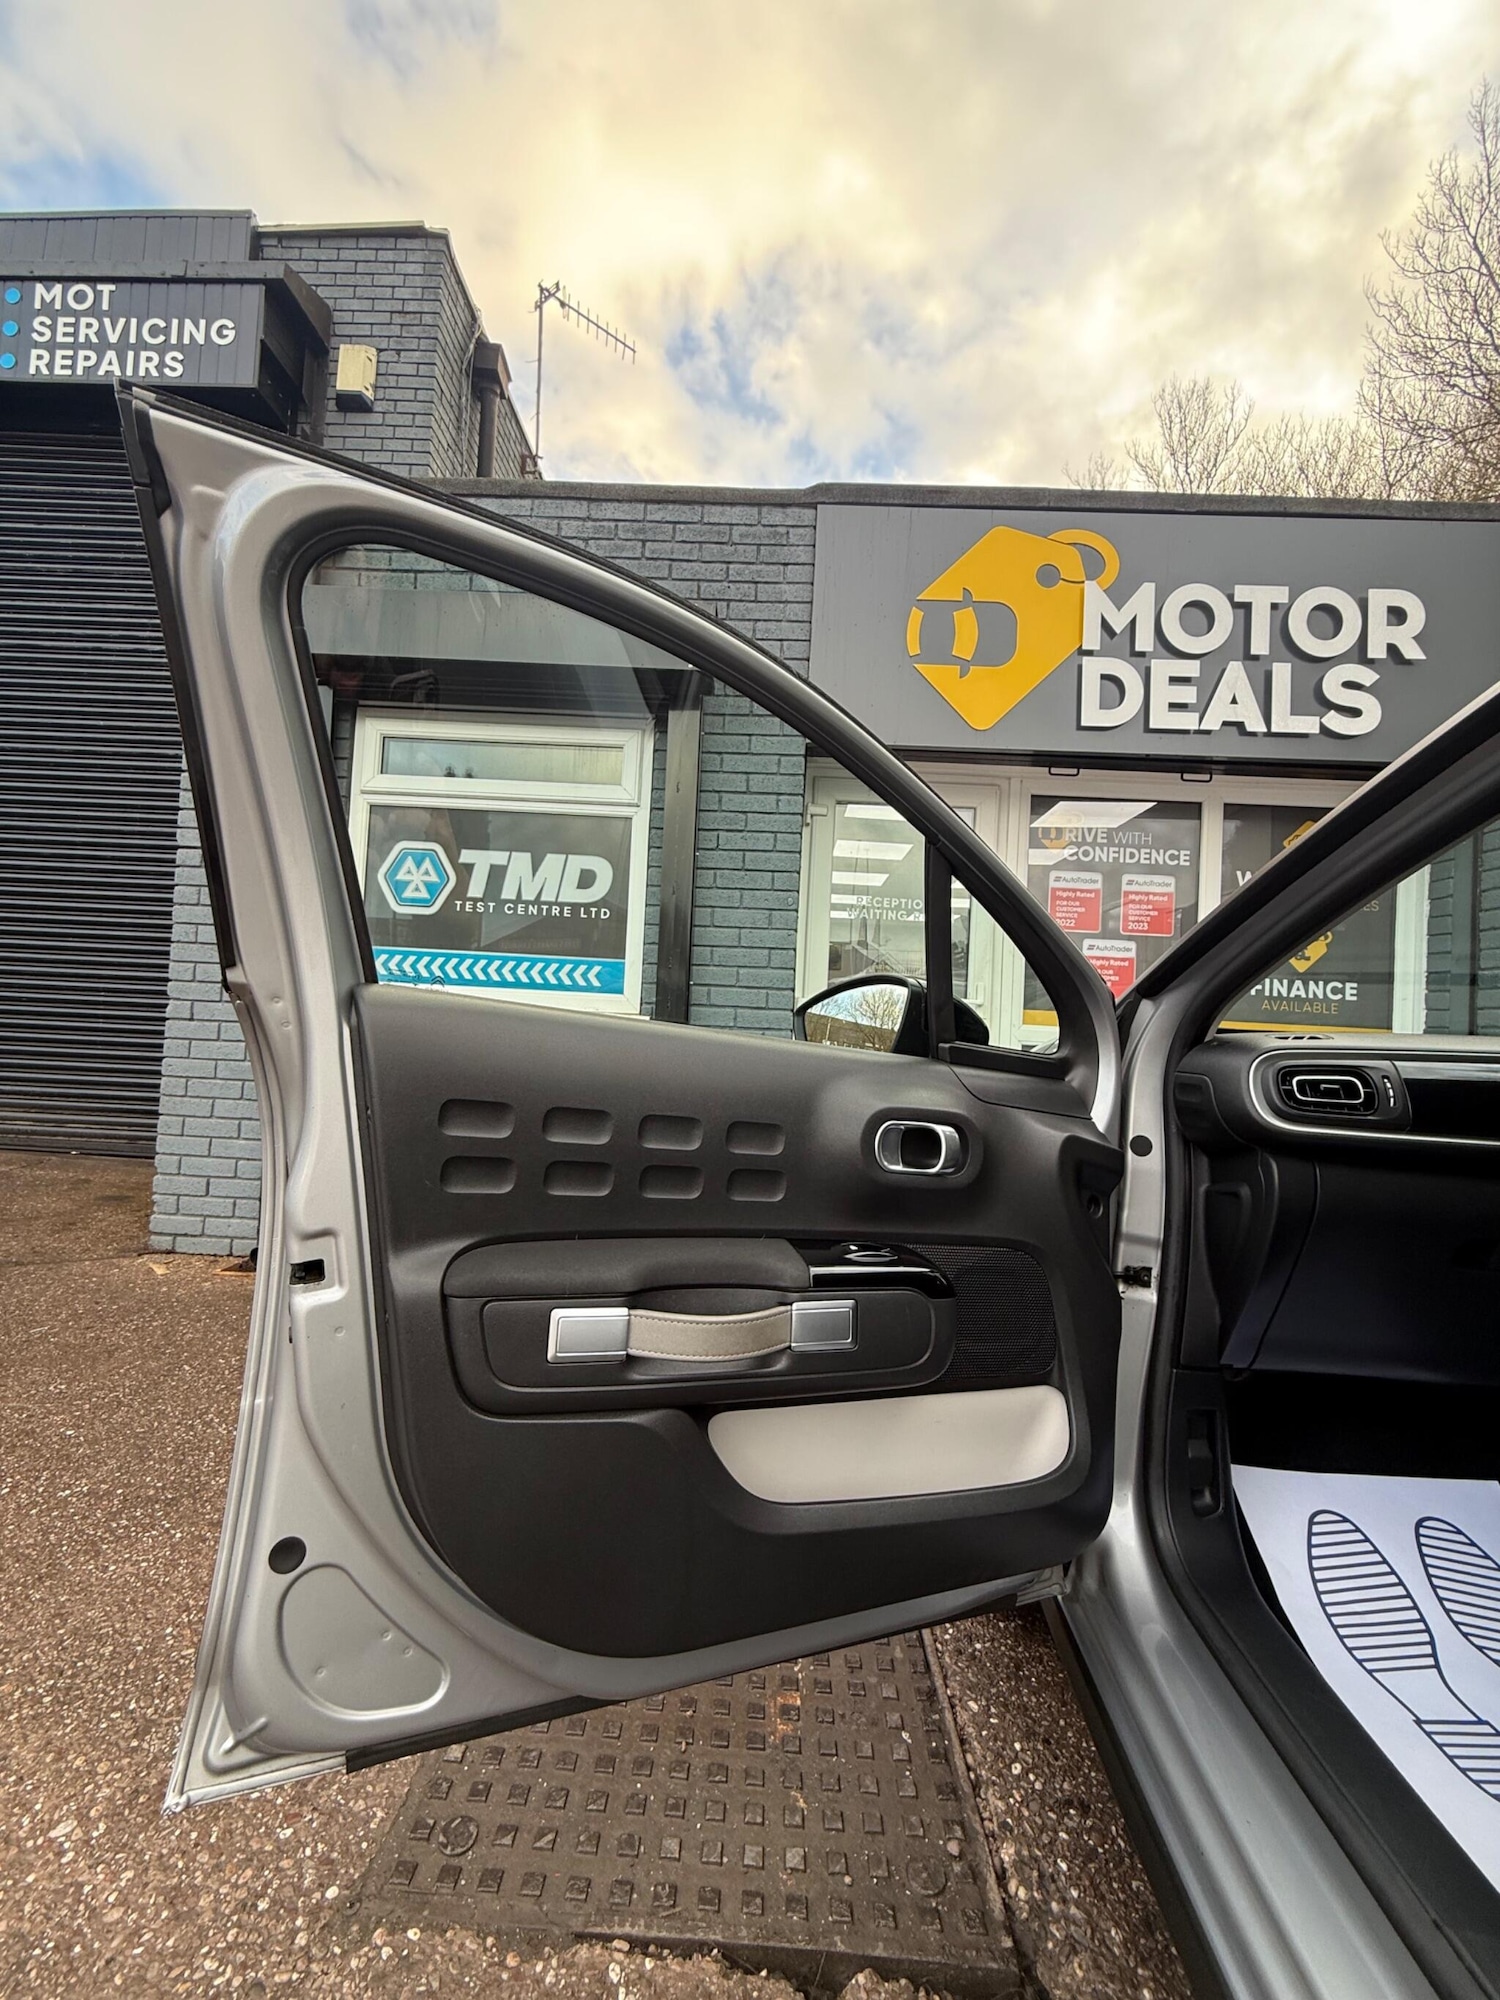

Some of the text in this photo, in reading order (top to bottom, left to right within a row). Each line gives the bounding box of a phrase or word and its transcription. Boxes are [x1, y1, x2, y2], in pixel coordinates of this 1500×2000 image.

[33, 283, 117, 311] MOT
[31, 316, 237, 346] SERVICING
[29, 348, 185, 377] REPAIRS
[1081, 579, 1427, 660] MOTOR
[1079, 656, 1383, 736] DEALS
[1113, 831, 1152, 845] WITH
[1064, 845, 1190, 866] CONFIDENCE
[458, 849, 614, 904] TMD
[1062, 876, 1099, 885] AutoTrader
[1135, 880, 1172, 888] AutoTrader
[1056, 890, 1076, 898] Highly
[1128, 893, 1148, 902] Highly
[454, 901, 611, 919] TEST CENTRE LTD
[856, 896, 923, 910] RECEPTIO
[847, 907, 907, 921] WAITING
[1127, 922, 1149, 930] 2023
[1096, 944, 1133, 952] AutoTrader
[1261, 1000, 1339, 1014] AVAILABLE
